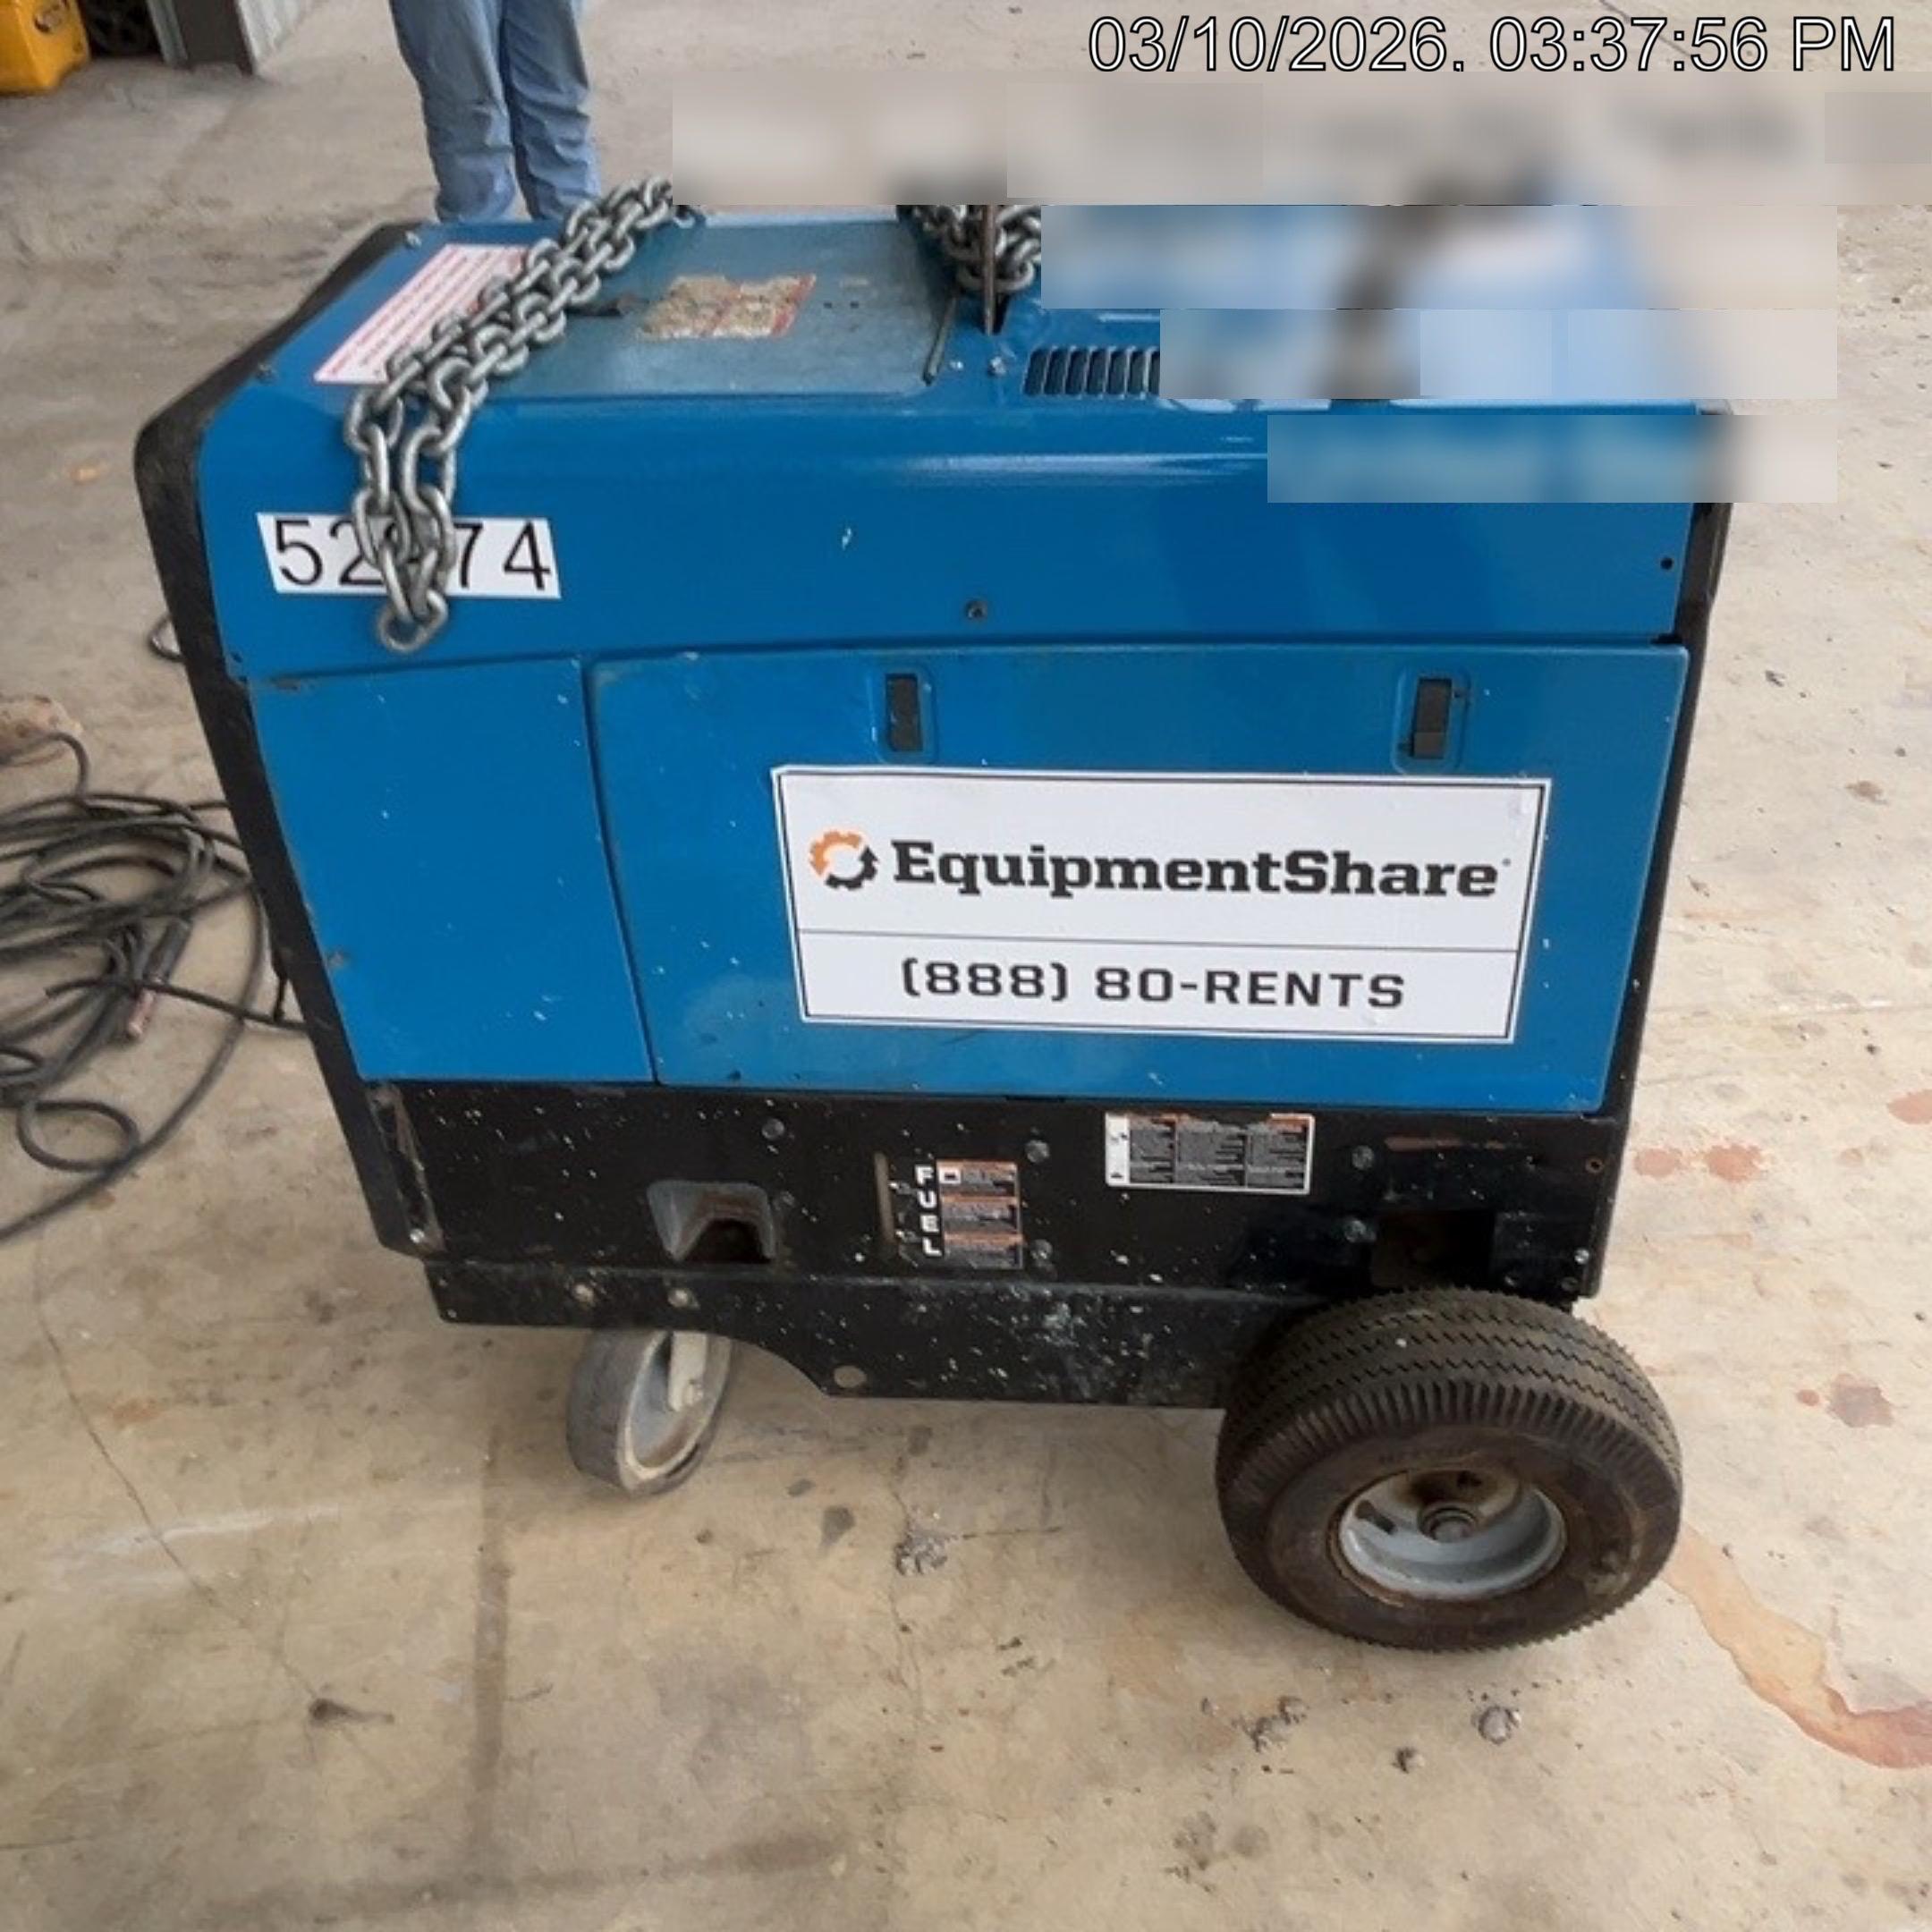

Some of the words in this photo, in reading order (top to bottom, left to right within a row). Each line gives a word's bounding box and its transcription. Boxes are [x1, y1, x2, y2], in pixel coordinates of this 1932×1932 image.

[273, 518, 551, 590] 5274
[892, 839, 1498, 899] EquipmentShare
[902, 957, 1068, 1002] (888)
[1095, 967, 1404, 1008] 80-RENTS
[915, 1165, 942, 1257] FUEL
